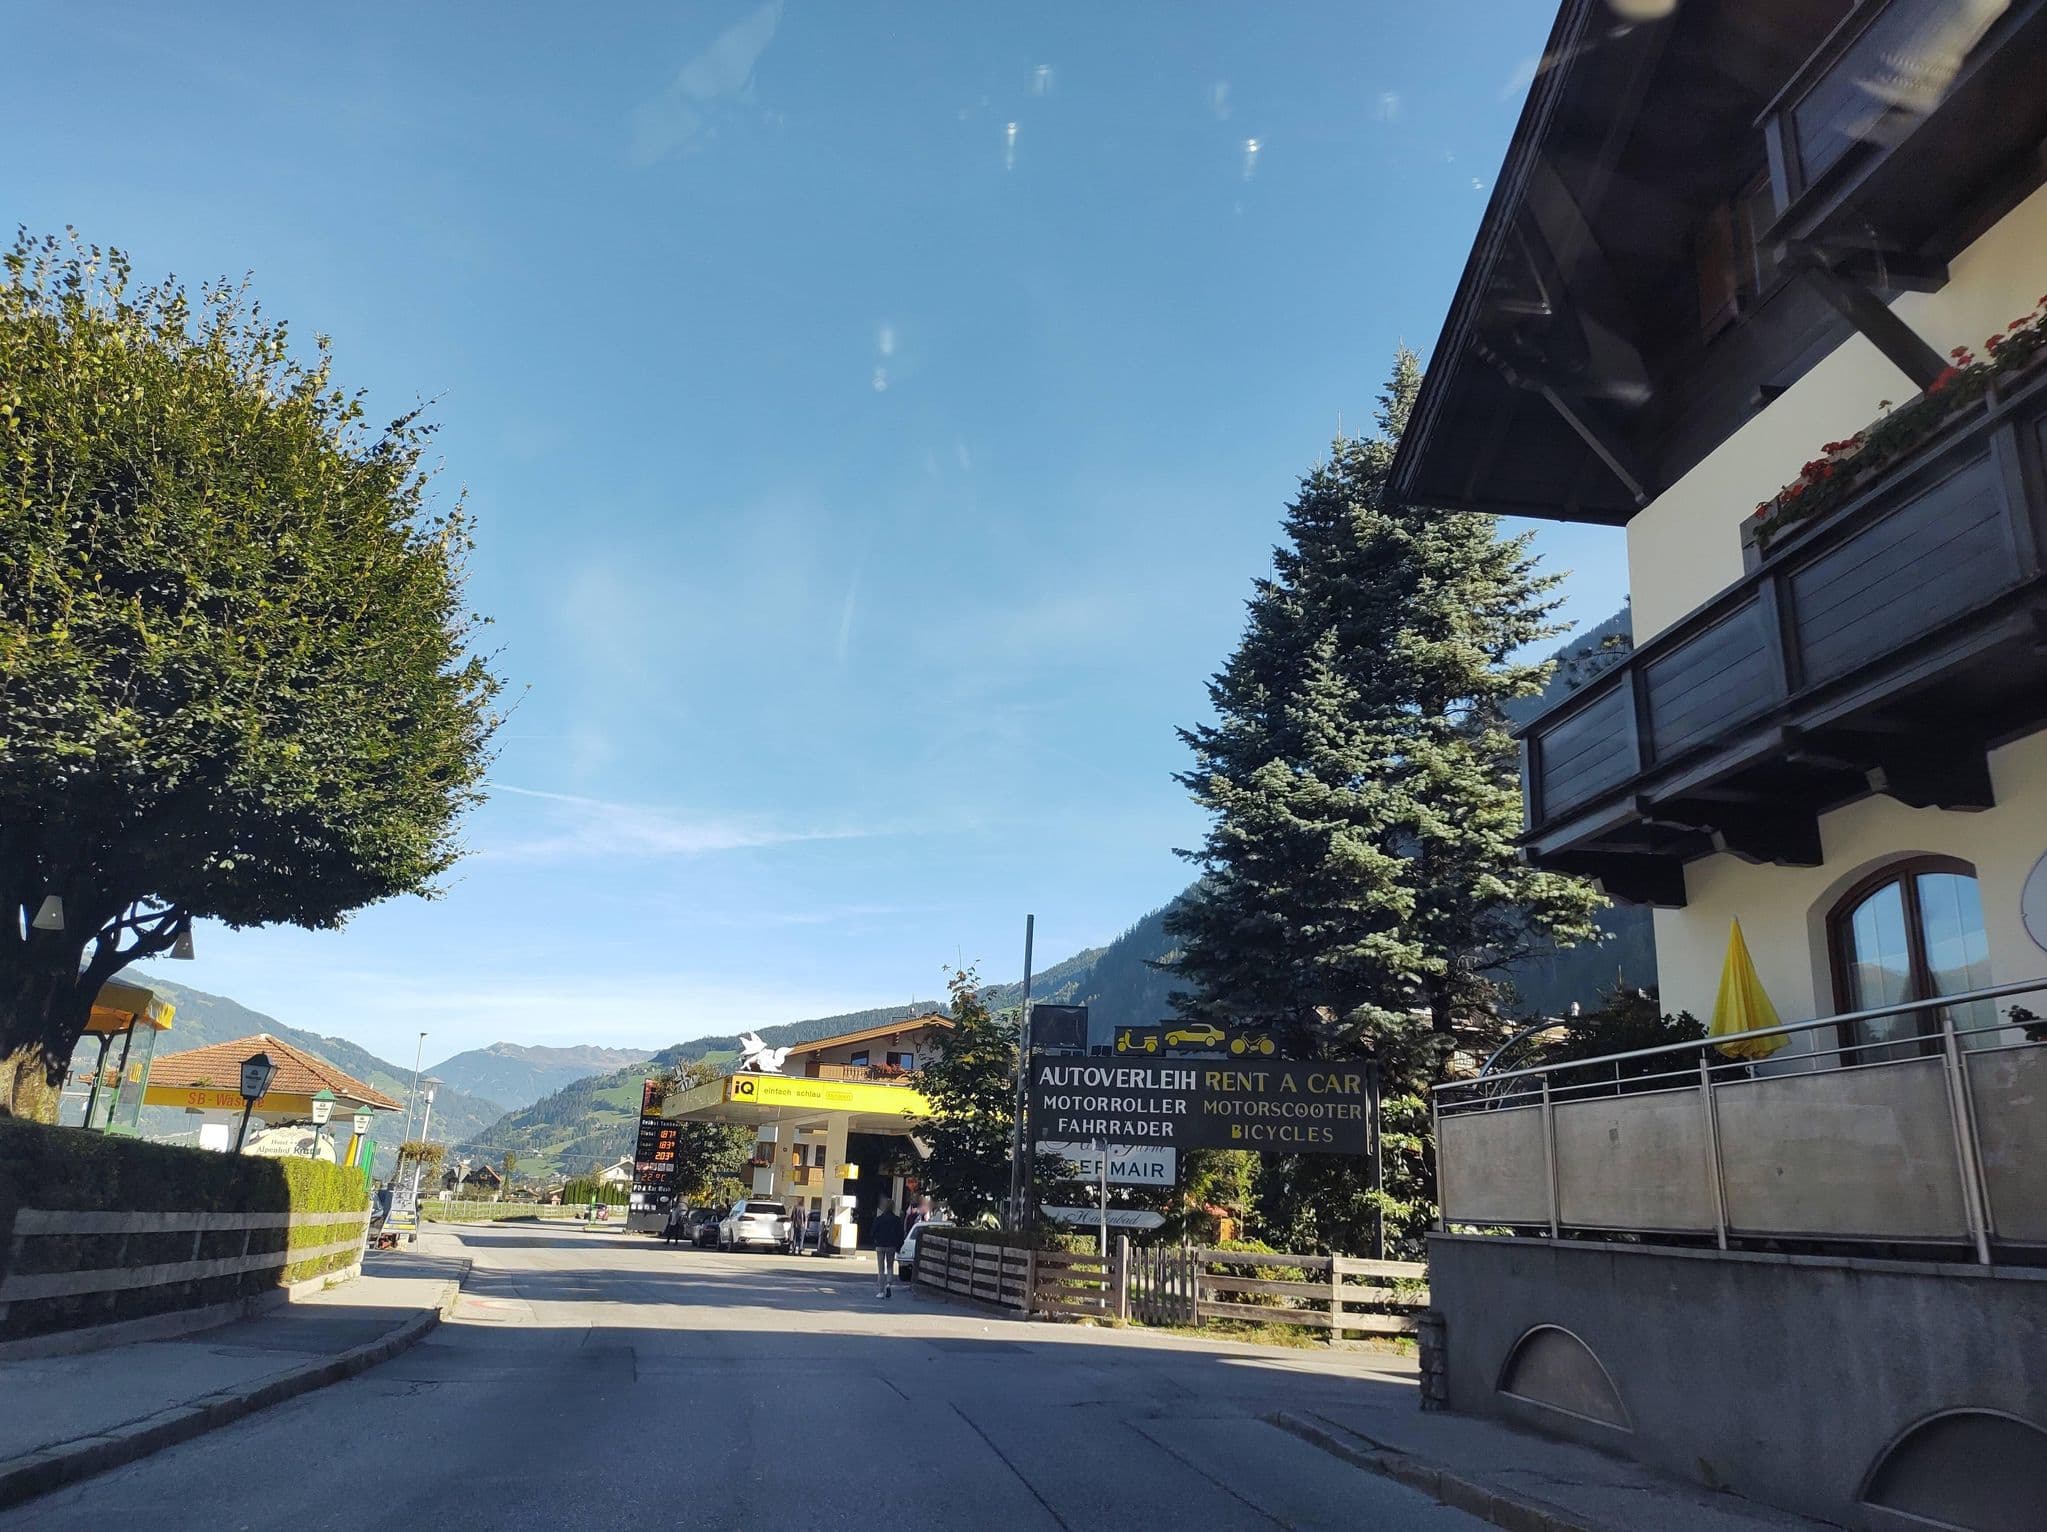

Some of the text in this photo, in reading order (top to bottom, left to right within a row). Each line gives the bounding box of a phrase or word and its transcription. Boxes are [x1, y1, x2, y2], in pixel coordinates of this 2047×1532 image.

[1039, 1066, 1196, 1090] AUTOVERLEIH
[1205, 1071, 1361, 1094] RENT A CAR
[734, 1081, 755, 1095] iQ
[764, 1088, 792, 1096] einfach
[796, 1090, 821, 1098] schlau
[188, 1092, 206, 1105] SB
[1043, 1095, 1187, 1114] MOTORROLLER
[1203, 1100, 1362, 1119] MOTORSCOOTER
[1058, 1118, 1174, 1137] FAHRRÄDER
[1231, 1124, 1334, 1143] BICYCLES
